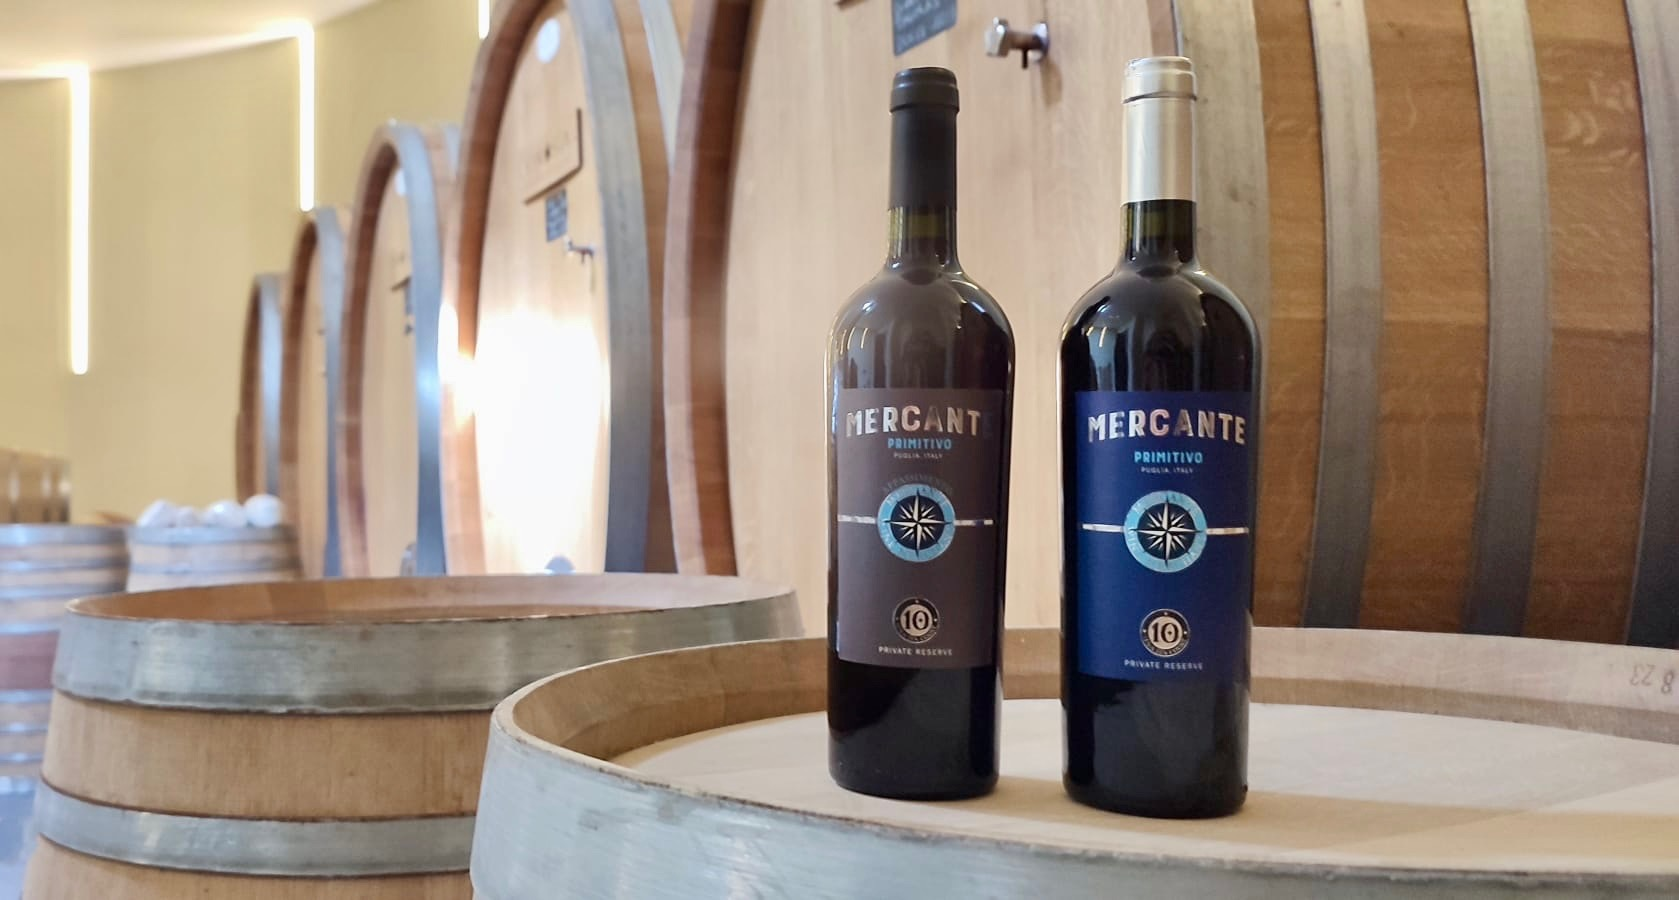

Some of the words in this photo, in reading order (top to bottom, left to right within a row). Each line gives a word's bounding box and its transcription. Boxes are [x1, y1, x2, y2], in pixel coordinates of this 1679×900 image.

[1087, 408, 1247, 446] MERCANTE
[887, 437, 953, 450] PRIMITIVO
[923, 452, 943, 460] ITALY
[1134, 450, 1204, 464] PRIMITIVO
[1173, 466, 1194, 475] ITALY
[904, 610, 930, 630] 10
[1151, 622, 1179, 643] 10
[877, 645, 913, 656] PRIVATE
[915, 647, 953, 657] RESERVE
[1123, 658, 1161, 670] PRIVATE
[1163, 661, 1204, 672] RESERVE
